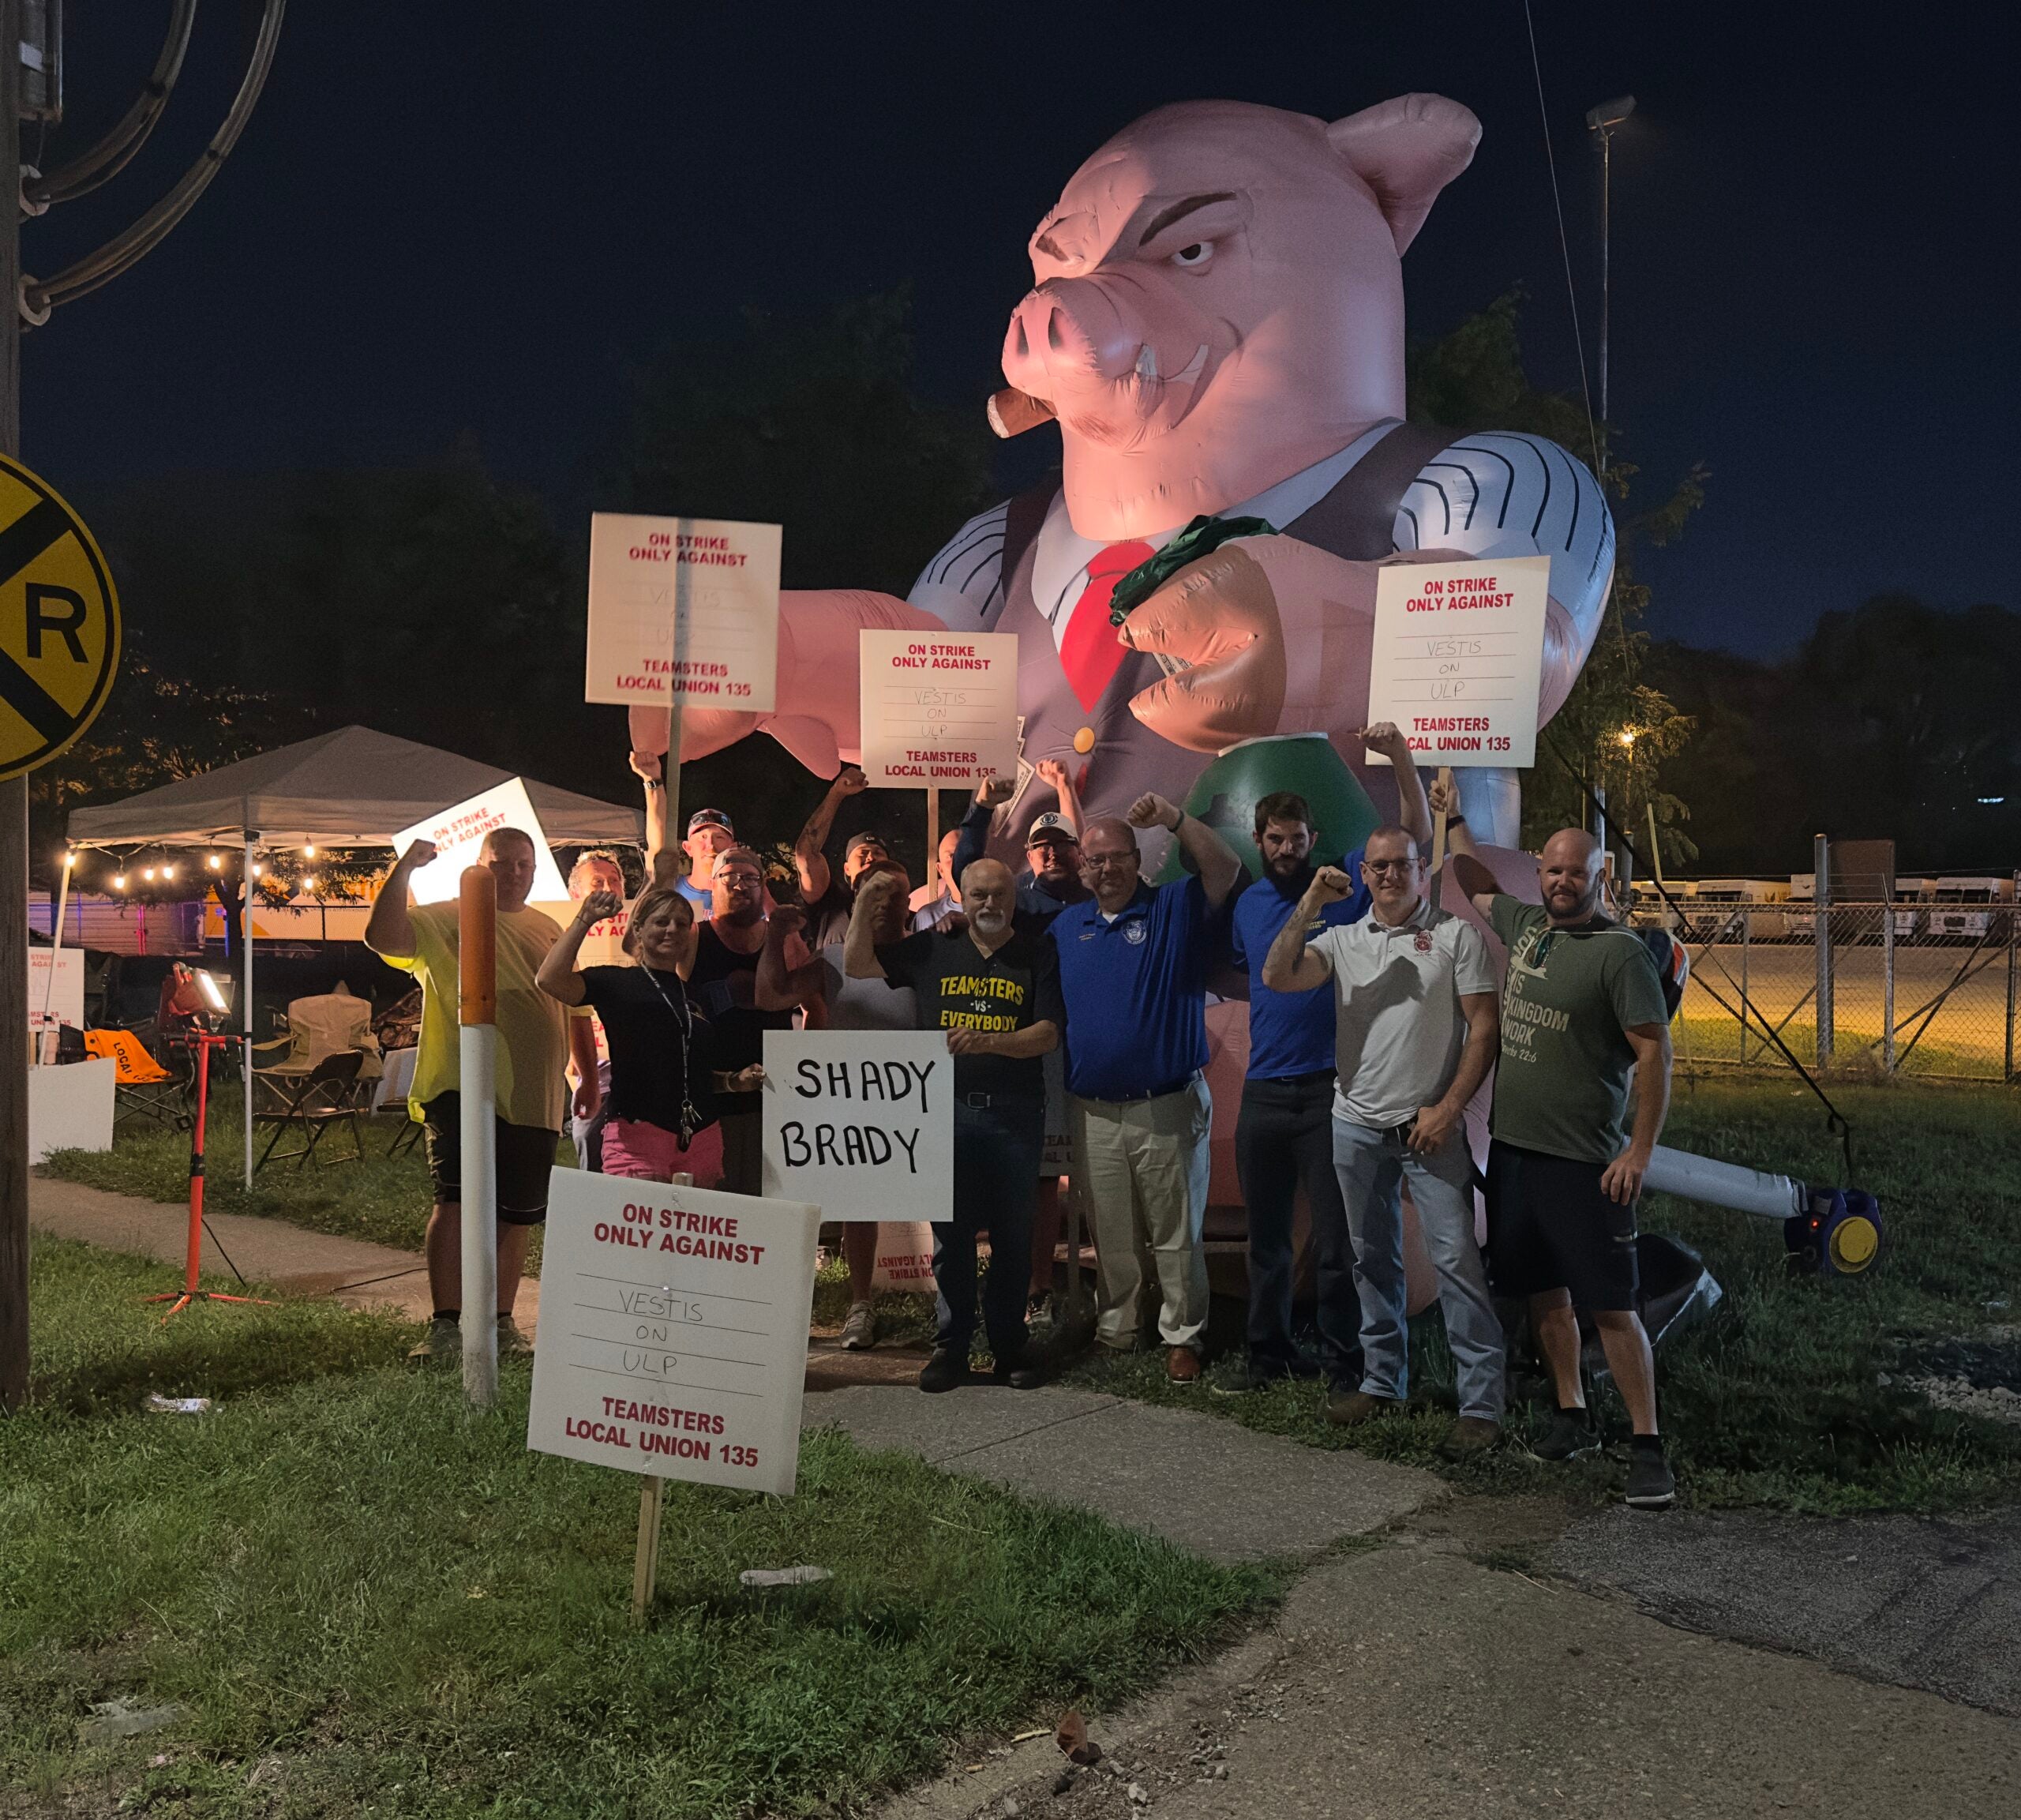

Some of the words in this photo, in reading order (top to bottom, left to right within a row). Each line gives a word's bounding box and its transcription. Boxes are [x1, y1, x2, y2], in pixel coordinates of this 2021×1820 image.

[649, 533, 670, 546] ON
[676, 535, 729, 550] STRIKE
[629, 547, 672, 562] ONLY
[677, 550, 748, 567] AGAINST
[1424, 581, 1443, 595] ON
[1447, 577, 1497, 593] STRIKE
[1406, 597, 1444, 612] ONLY
[1448, 594, 1514, 610] AGAINST
[25, 582, 89, 663] R
[908, 644, 926, 655] ON
[930, 645, 975, 657] STRIKE
[1427, 640, 1482, 657] VESTIS
[643, 659, 729, 677] TEAMSTERS
[892, 657, 928, 669] ONLY
[932, 659, 991, 670] AGAINST
[1439, 662, 1460, 674] ON
[617, 675, 666, 691] LOCAL
[671, 679, 719, 695] UNION
[726, 682, 752, 696] 135
[1430, 681, 1465, 700] ULP
[914, 691, 966, 705] VESTIS
[927, 708, 947, 719] ON
[921, 725, 947, 737] ULP
[1413, 717, 1490, 731] TEAMSTERS
[1406, 737, 1432, 750] CAL
[1437, 737, 1481, 750] UNION
[1487, 737, 1510, 750] 135
[906, 751, 977, 763] TEAMSTERS
[885, 765, 925, 776] LOCAL
[930, 767, 970, 778] UNION
[976, 767, 996, 779] 135
[433, 826, 449, 840] ON
[452, 807, 490, 832] STRIKE
[433, 837, 456, 854] NLY
[459, 812, 507, 843] AGAINST
[940, 976, 1024, 1006] TEAMSTERS
[939, 1010, 1018, 1031] EVERYBODY
[1509, 996, 1569, 1032] KINGDOM
[1502, 1016, 1535, 1046] WORK
[1519, 1049, 1537, 1063] 22:6
[795, 1059, 936, 1113] SHADY
[780, 1120, 921, 1174] BRADY
[623, 1203, 652, 1225] ON
[659, 1209, 738, 1238] STRIKE
[594, 1223, 654, 1249] ONLY
[660, 1235, 765, 1265] AGAINST
[877, 1255, 916, 1268] AGAINST
[889, 1268, 920, 1279] STRIKE
[619, 1289, 703, 1323] VESTIS
[636, 1325, 668, 1342] ON
[623, 1350, 677, 1375] ULP
[602, 1396, 725, 1435] TEAMSTERS
[565, 1417, 631, 1448] LOCAL
[640, 1432, 710, 1462] UNION
[719, 1445, 759, 1467] 135
